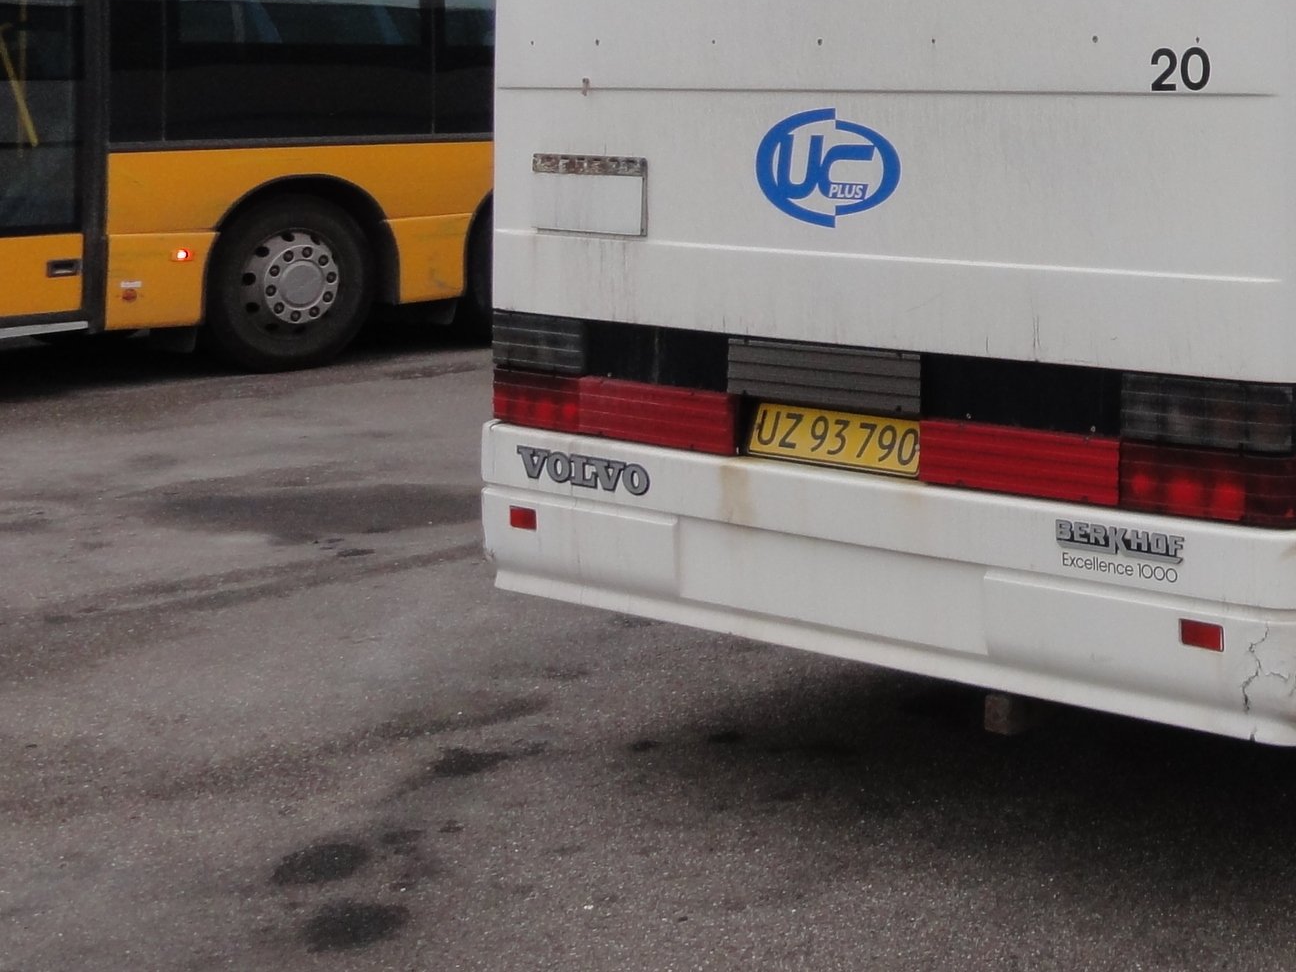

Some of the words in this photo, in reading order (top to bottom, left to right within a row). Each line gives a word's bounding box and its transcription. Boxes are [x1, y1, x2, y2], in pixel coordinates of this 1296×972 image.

[1150, 46, 1212, 92] 20
[829, 184, 864, 199] PLUS
[757, 409, 804, 449] UZ
[810, 415, 851, 455] 93
[856, 422, 919, 466] 790
[517, 444, 651, 496] VOLVO
[1055, 519, 1185, 564] BERKHOF
[1062, 552, 1134, 576] Excellence
[1137, 563, 1178, 583] 1000
